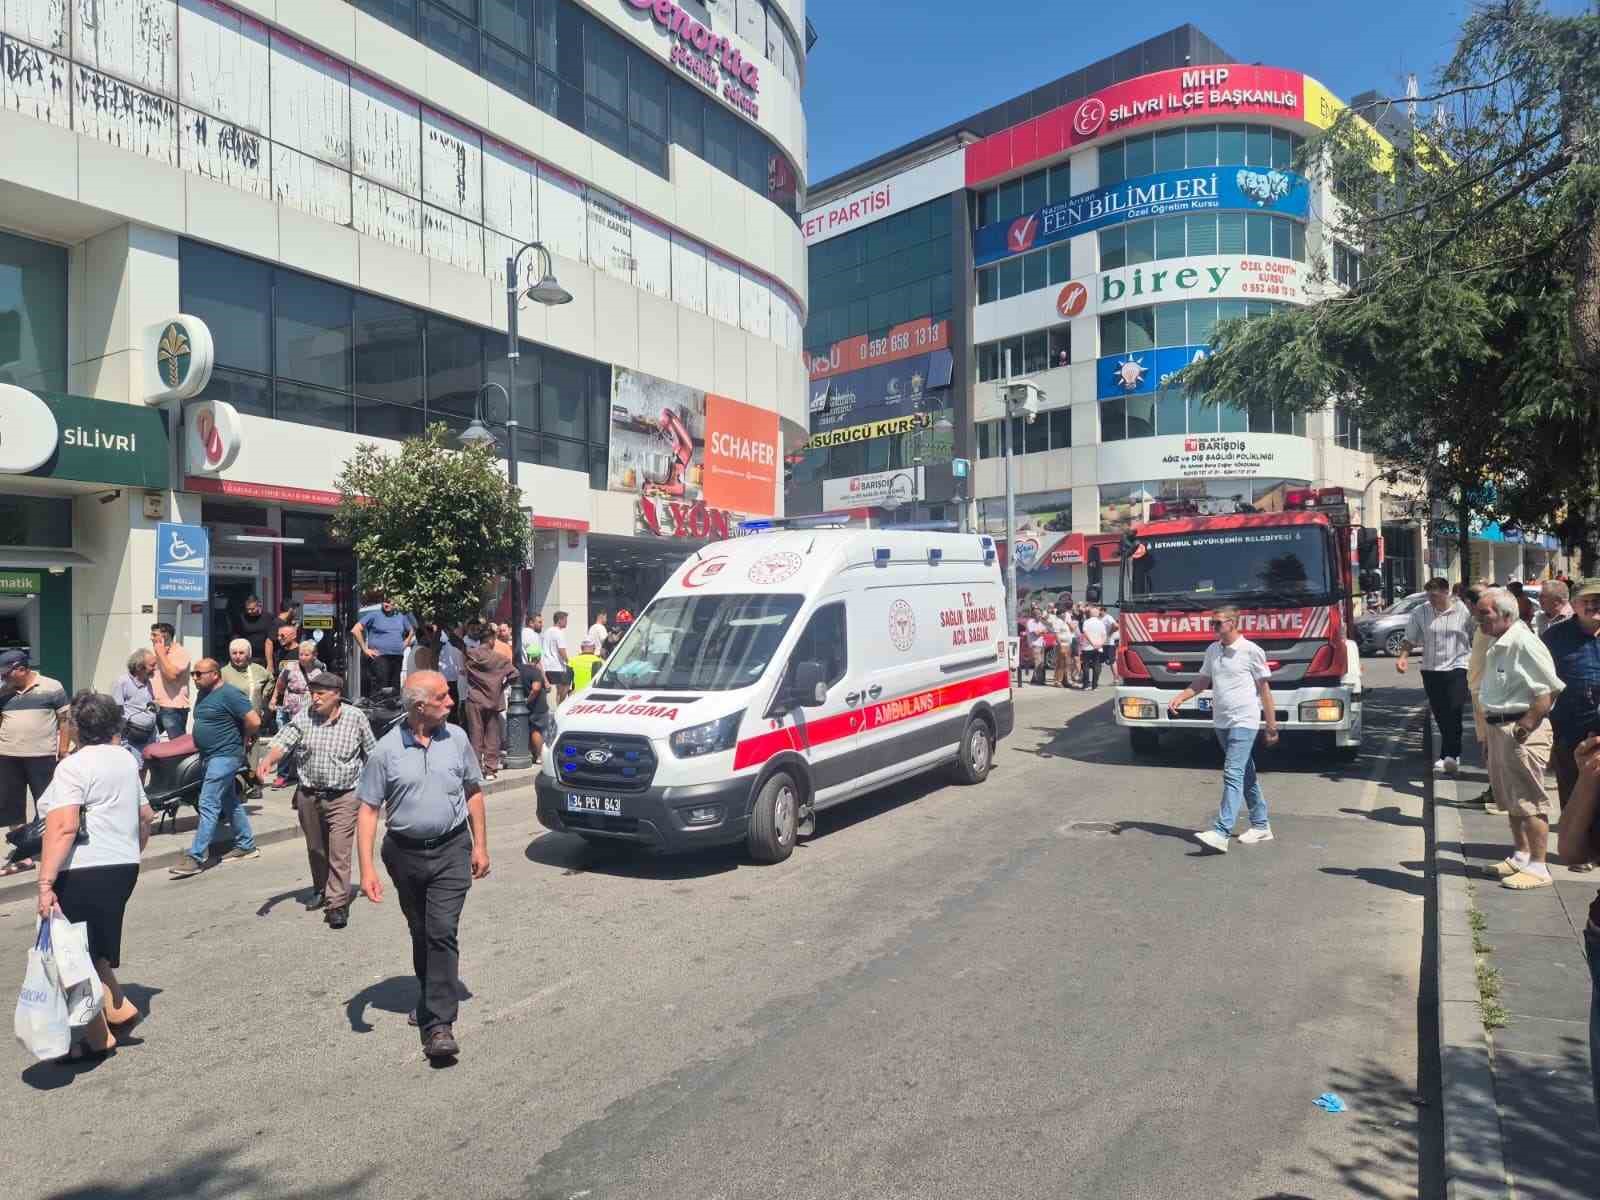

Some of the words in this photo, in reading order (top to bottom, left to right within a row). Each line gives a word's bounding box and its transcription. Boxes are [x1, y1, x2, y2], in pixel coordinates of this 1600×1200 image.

[1181, 68, 1230, 90] MHP
[1108, 95, 1164, 123] SİLİVRİ
[1167, 92, 1204, 111] İLÇE
[1209, 88, 1298, 107] BAŞKANLIĞI
[828, 183, 892, 230] PARTİSİ
[1043, 205, 1083, 234] FEN
[1089, 172, 1219, 219] BİLİMLERİ
[1127, 207, 1149, 219] Özel
[1151, 201, 1190, 215] Öğretim
[1191, 198, 1219, 209] Kursu
[1101, 268, 1231, 304] birey
[869, 338, 887, 358] 552
[64, 426, 136, 452] SİLİVRİ
[711, 431, 774, 466] SCHAFER
[1155, 540, 1191, 550] İSTANBUL
[874, 693, 934, 725] AMBULANS
[574, 795, 583, 807] 34
[585, 796, 601, 809] PEV
[604, 798, 619, 811] 643
